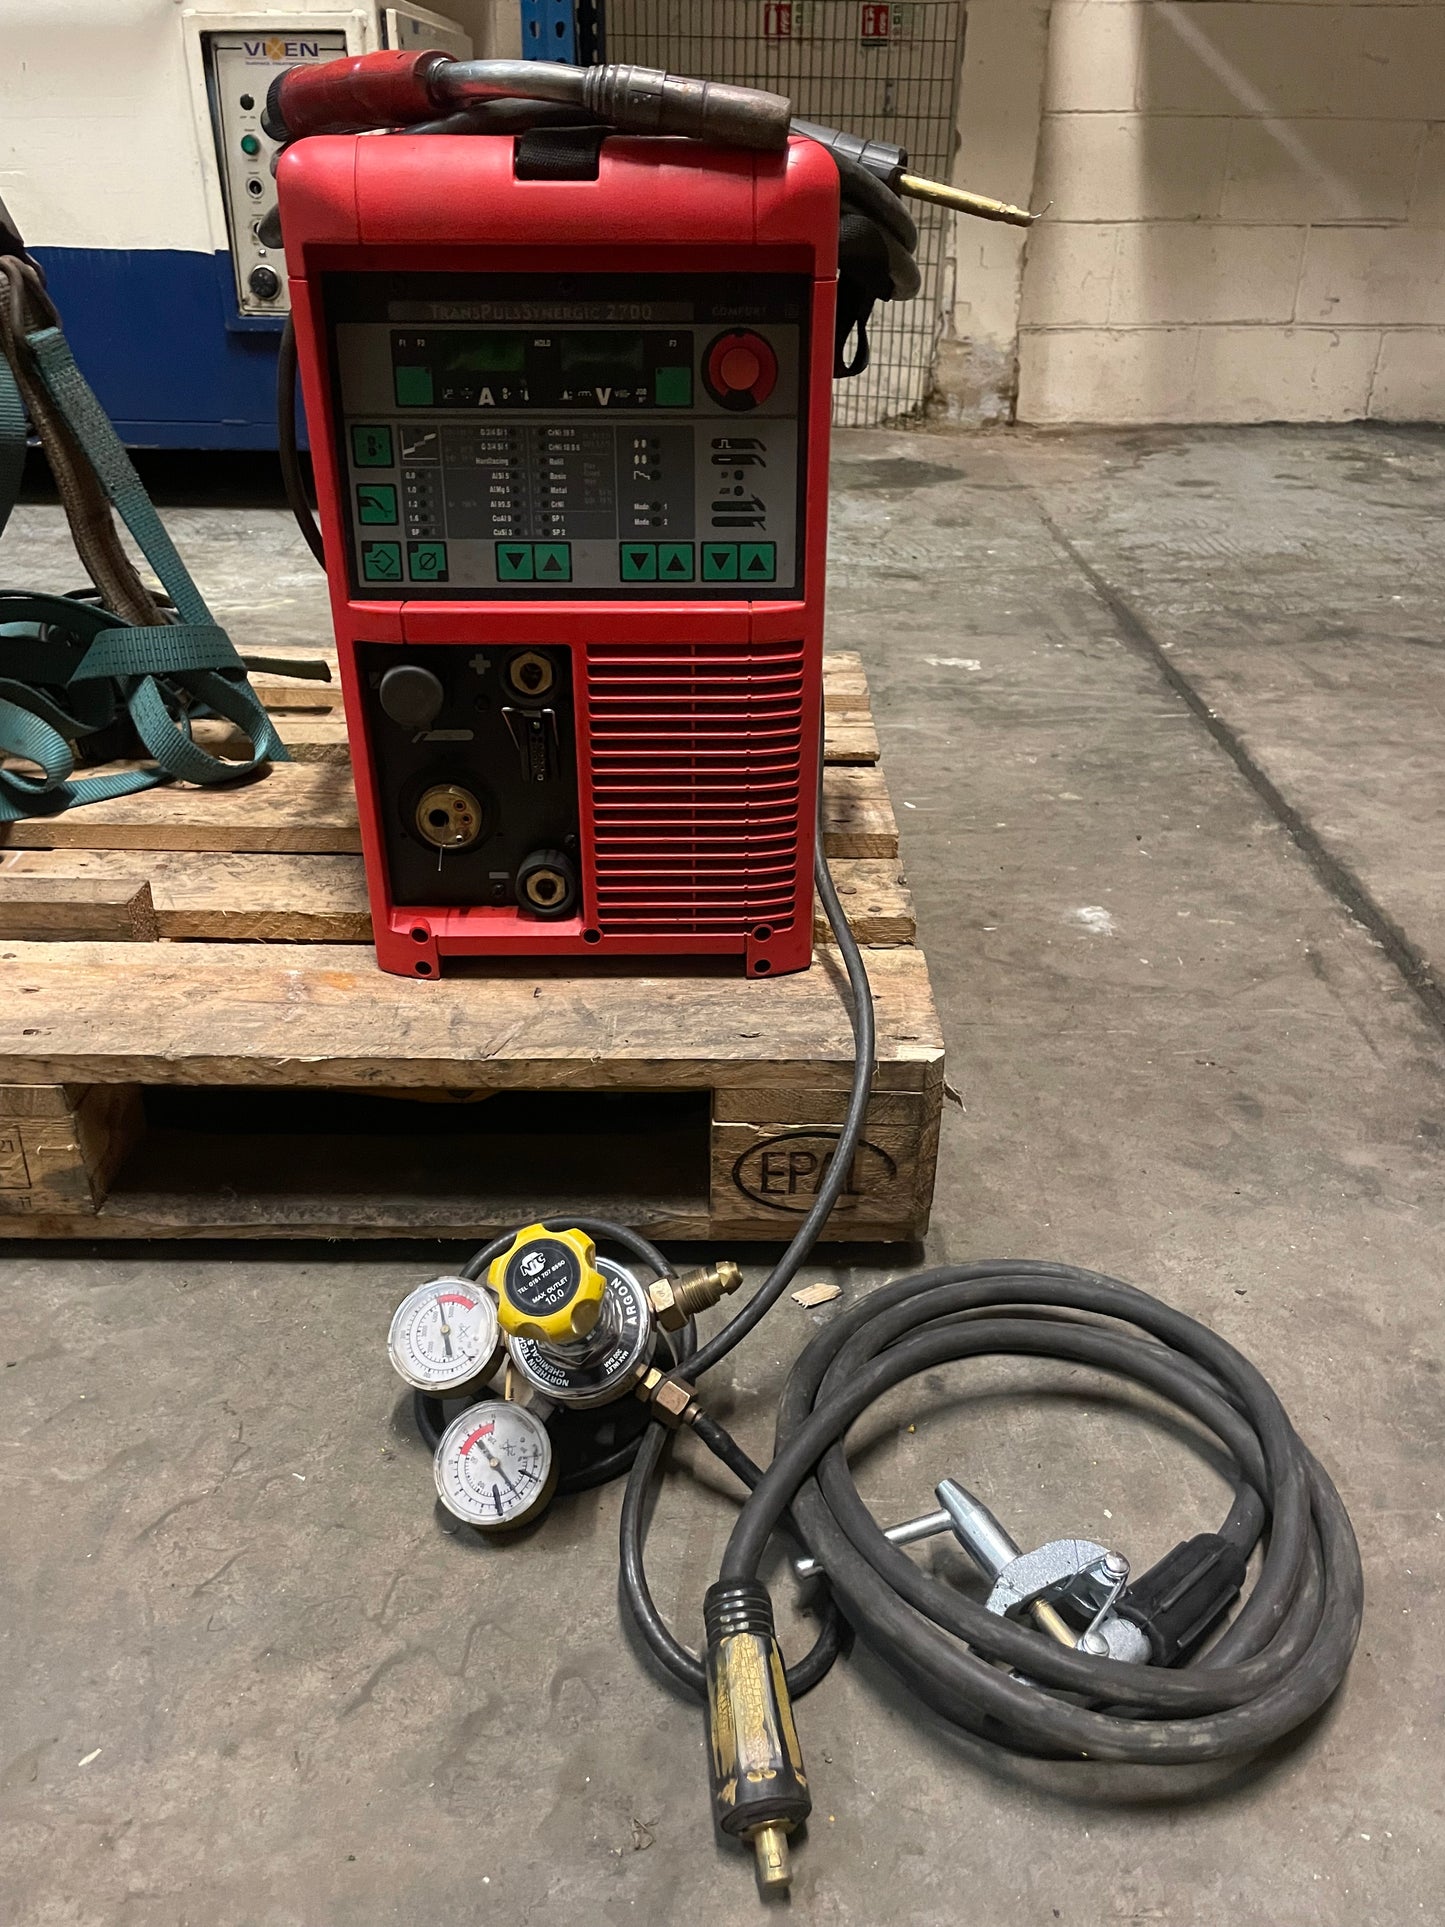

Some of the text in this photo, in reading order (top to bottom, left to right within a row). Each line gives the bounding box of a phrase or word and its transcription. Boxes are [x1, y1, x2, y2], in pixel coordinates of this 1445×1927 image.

[606, 303, 652, 320] 2700
[533, 338, 552, 348] HOLD
[478, 386, 496, 406] A
[595, 387, 613, 406] V
[550, 486, 568, 494] Metal
[633, 503, 650, 511] Mode
[634, 518, 650, 526] Mode
[517, 1286, 528, 1295] TEL
[531, 1276, 569, 1304] MAX OUTLET
[544, 1290, 565, 1306] 10.0
[610, 1277, 639, 1325] ARGON
[531, 1345, 566, 1378] CHEMICAL
[528, 1357, 570, 1387] NORTHERN
